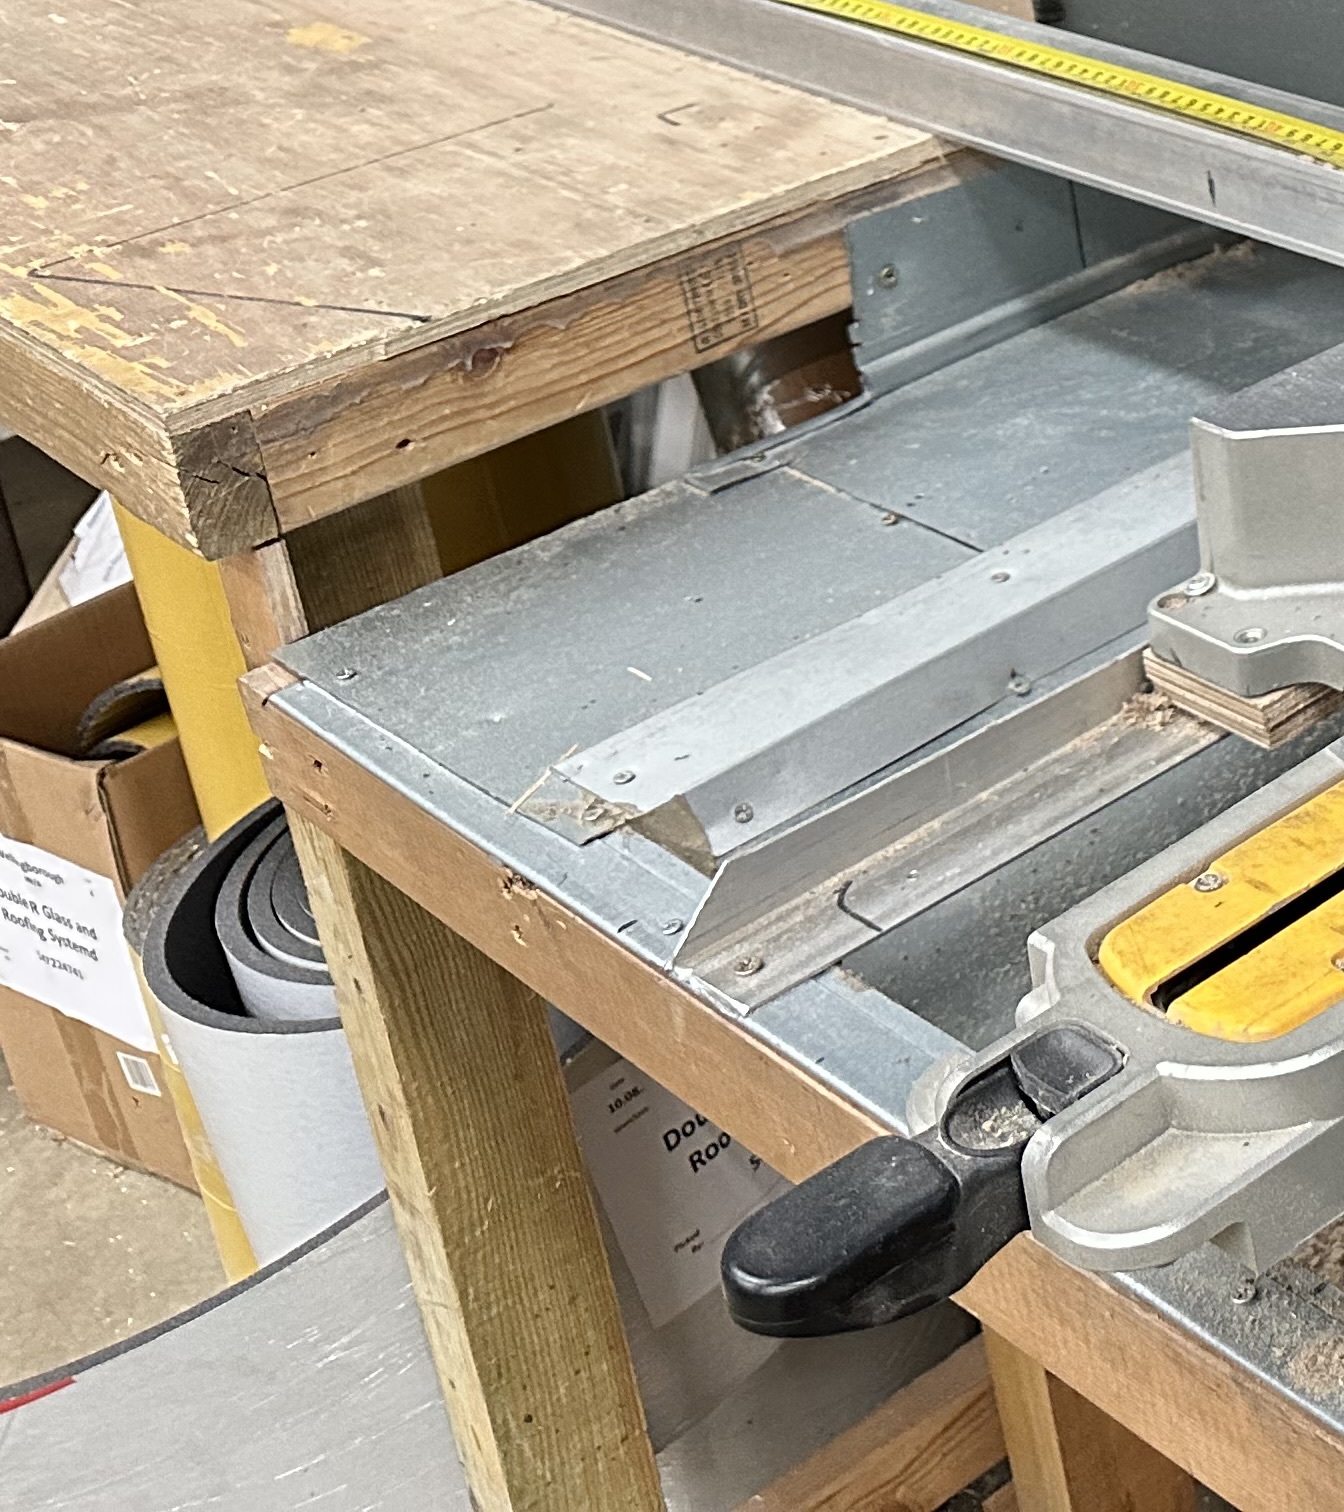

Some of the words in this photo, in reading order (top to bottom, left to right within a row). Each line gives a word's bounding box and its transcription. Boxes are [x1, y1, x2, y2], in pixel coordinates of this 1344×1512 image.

[1, 907, 47, 942] Roofing
[42, 904, 74, 930] Glass
[75, 921, 98, 941] and
